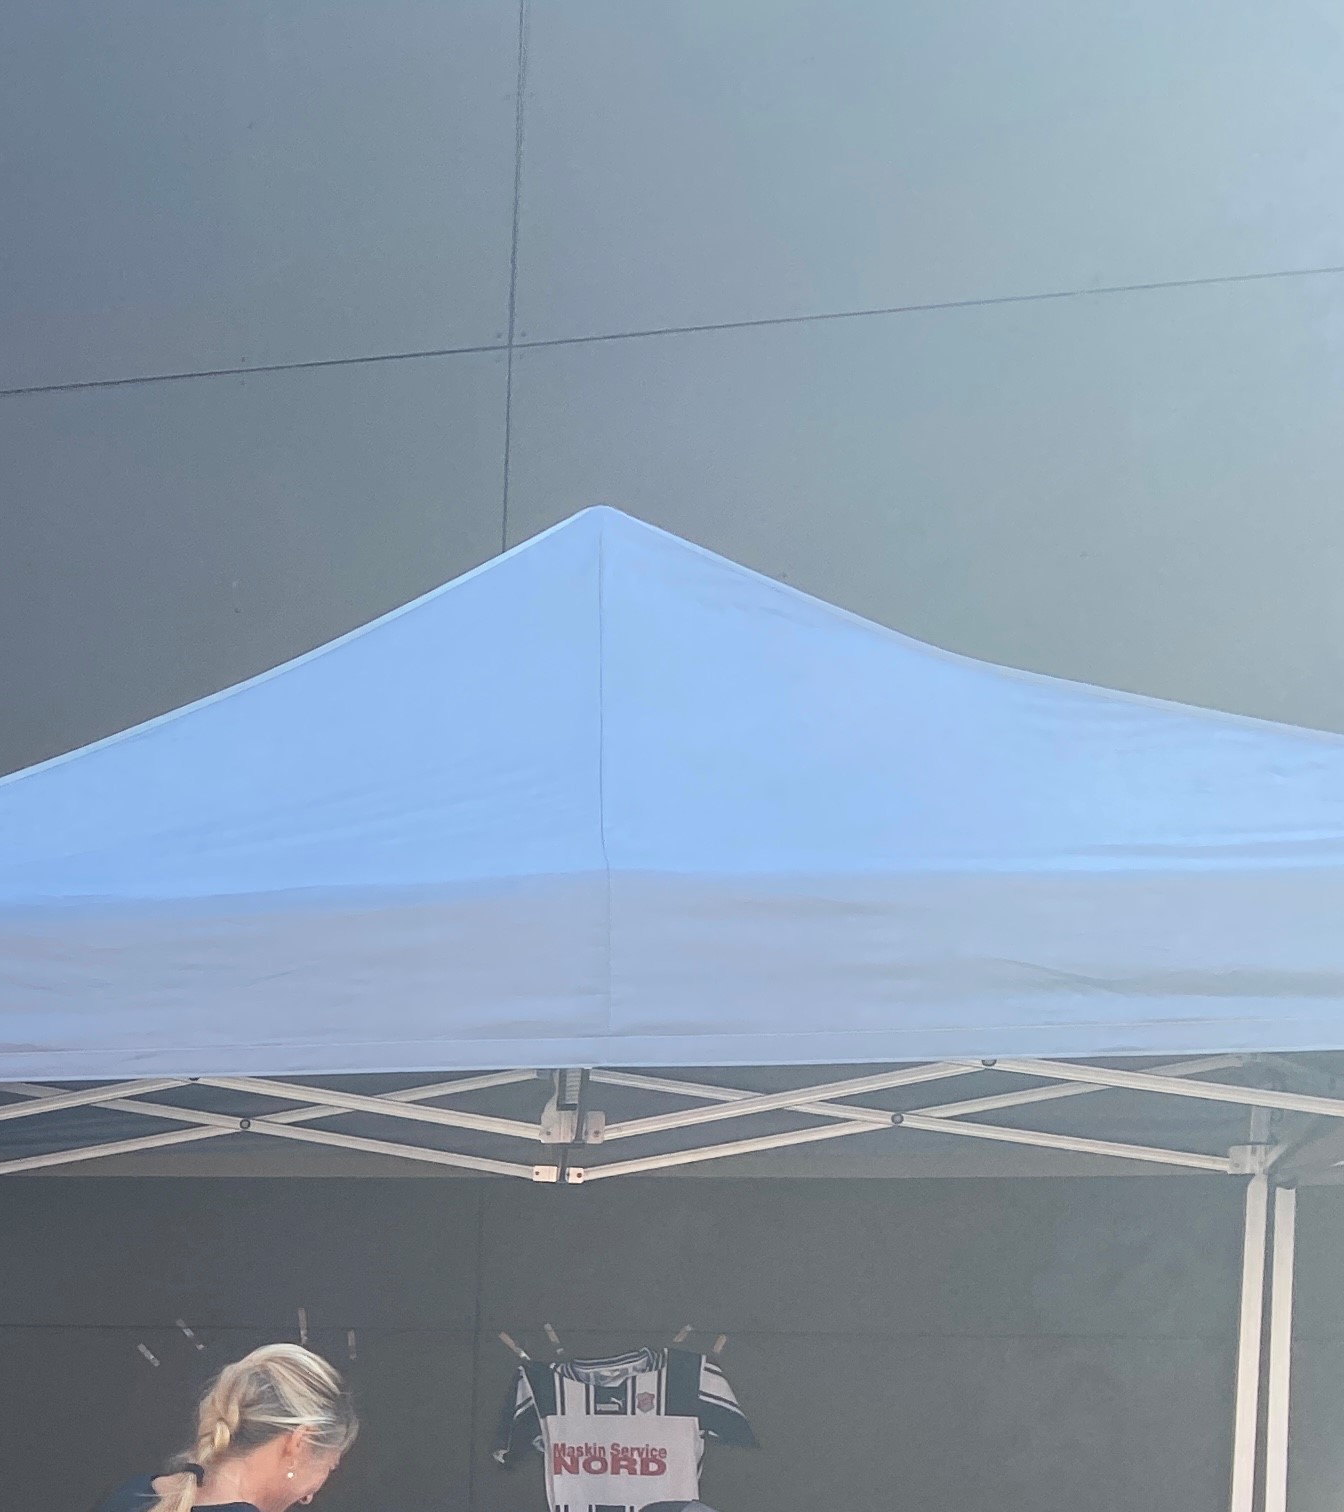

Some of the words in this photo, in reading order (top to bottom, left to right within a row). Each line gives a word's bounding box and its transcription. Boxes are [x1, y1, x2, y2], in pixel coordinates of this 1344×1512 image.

[553, 1442, 607, 1458] Maskin
[609, 1442, 668, 1460] Service
[553, 1456, 668, 1476] NORD
